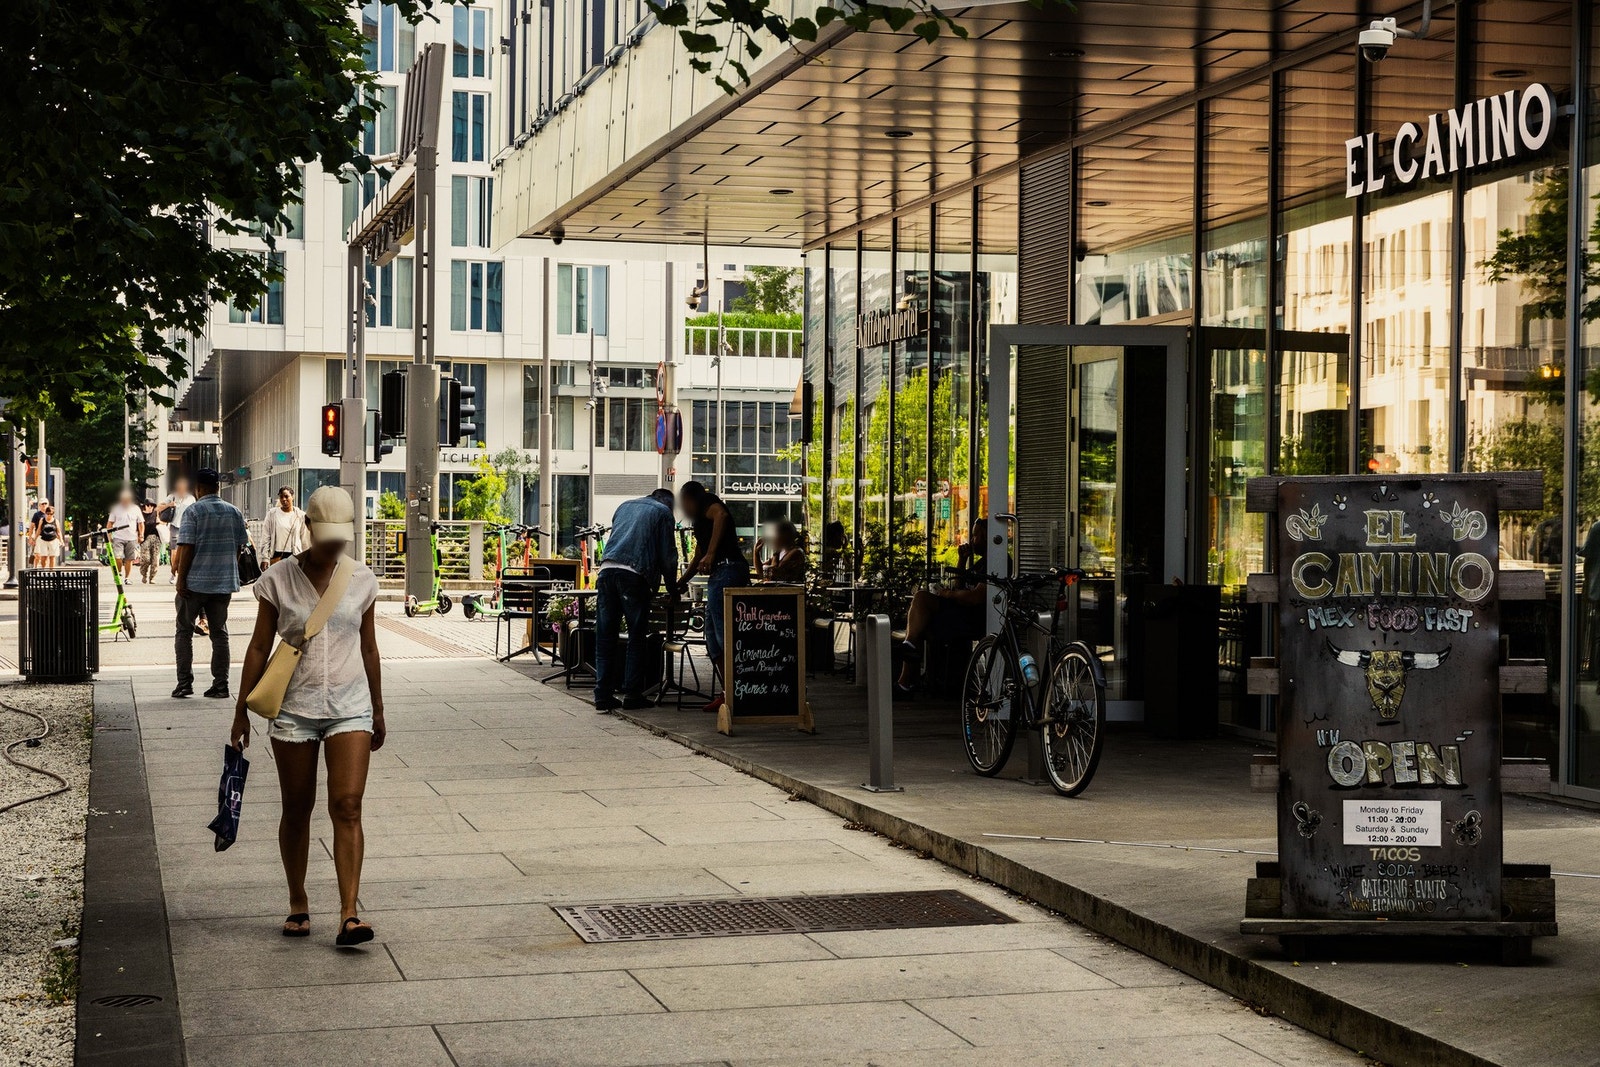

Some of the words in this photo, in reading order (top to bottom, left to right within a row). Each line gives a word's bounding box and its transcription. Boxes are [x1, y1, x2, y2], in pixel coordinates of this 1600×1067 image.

[1345, 135, 1385, 199] EL
[1393, 82, 1553, 183] CAMINO
[731, 481, 780, 492] CLARION
[1365, 509, 1417, 547] EL
[1291, 550, 1495, 603] CAMINO
[1308, 606, 1357, 630] MEX
[1366, 603, 1419, 632] FOOD
[1424, 606, 1474, 633] FAST
[1327, 740, 1463, 787] OPEN
[1360, 806, 1390, 815] Monday
[1400, 806, 1424, 815] Friday
[1355, 825, 1388, 834] Saturday
[1390, 825, 1396, 833] &
[1400, 825, 1429, 834] Sunday
[1395, 835, 1417, 843] 20:00
[1370, 847, 1421, 862] TACOS
[1329, 864, 1367, 878] WINE
[1377, 862, 1416, 877] SODA
[1422, 864, 1460, 878] BEER
[1361, 878, 1408, 898] CATERING
